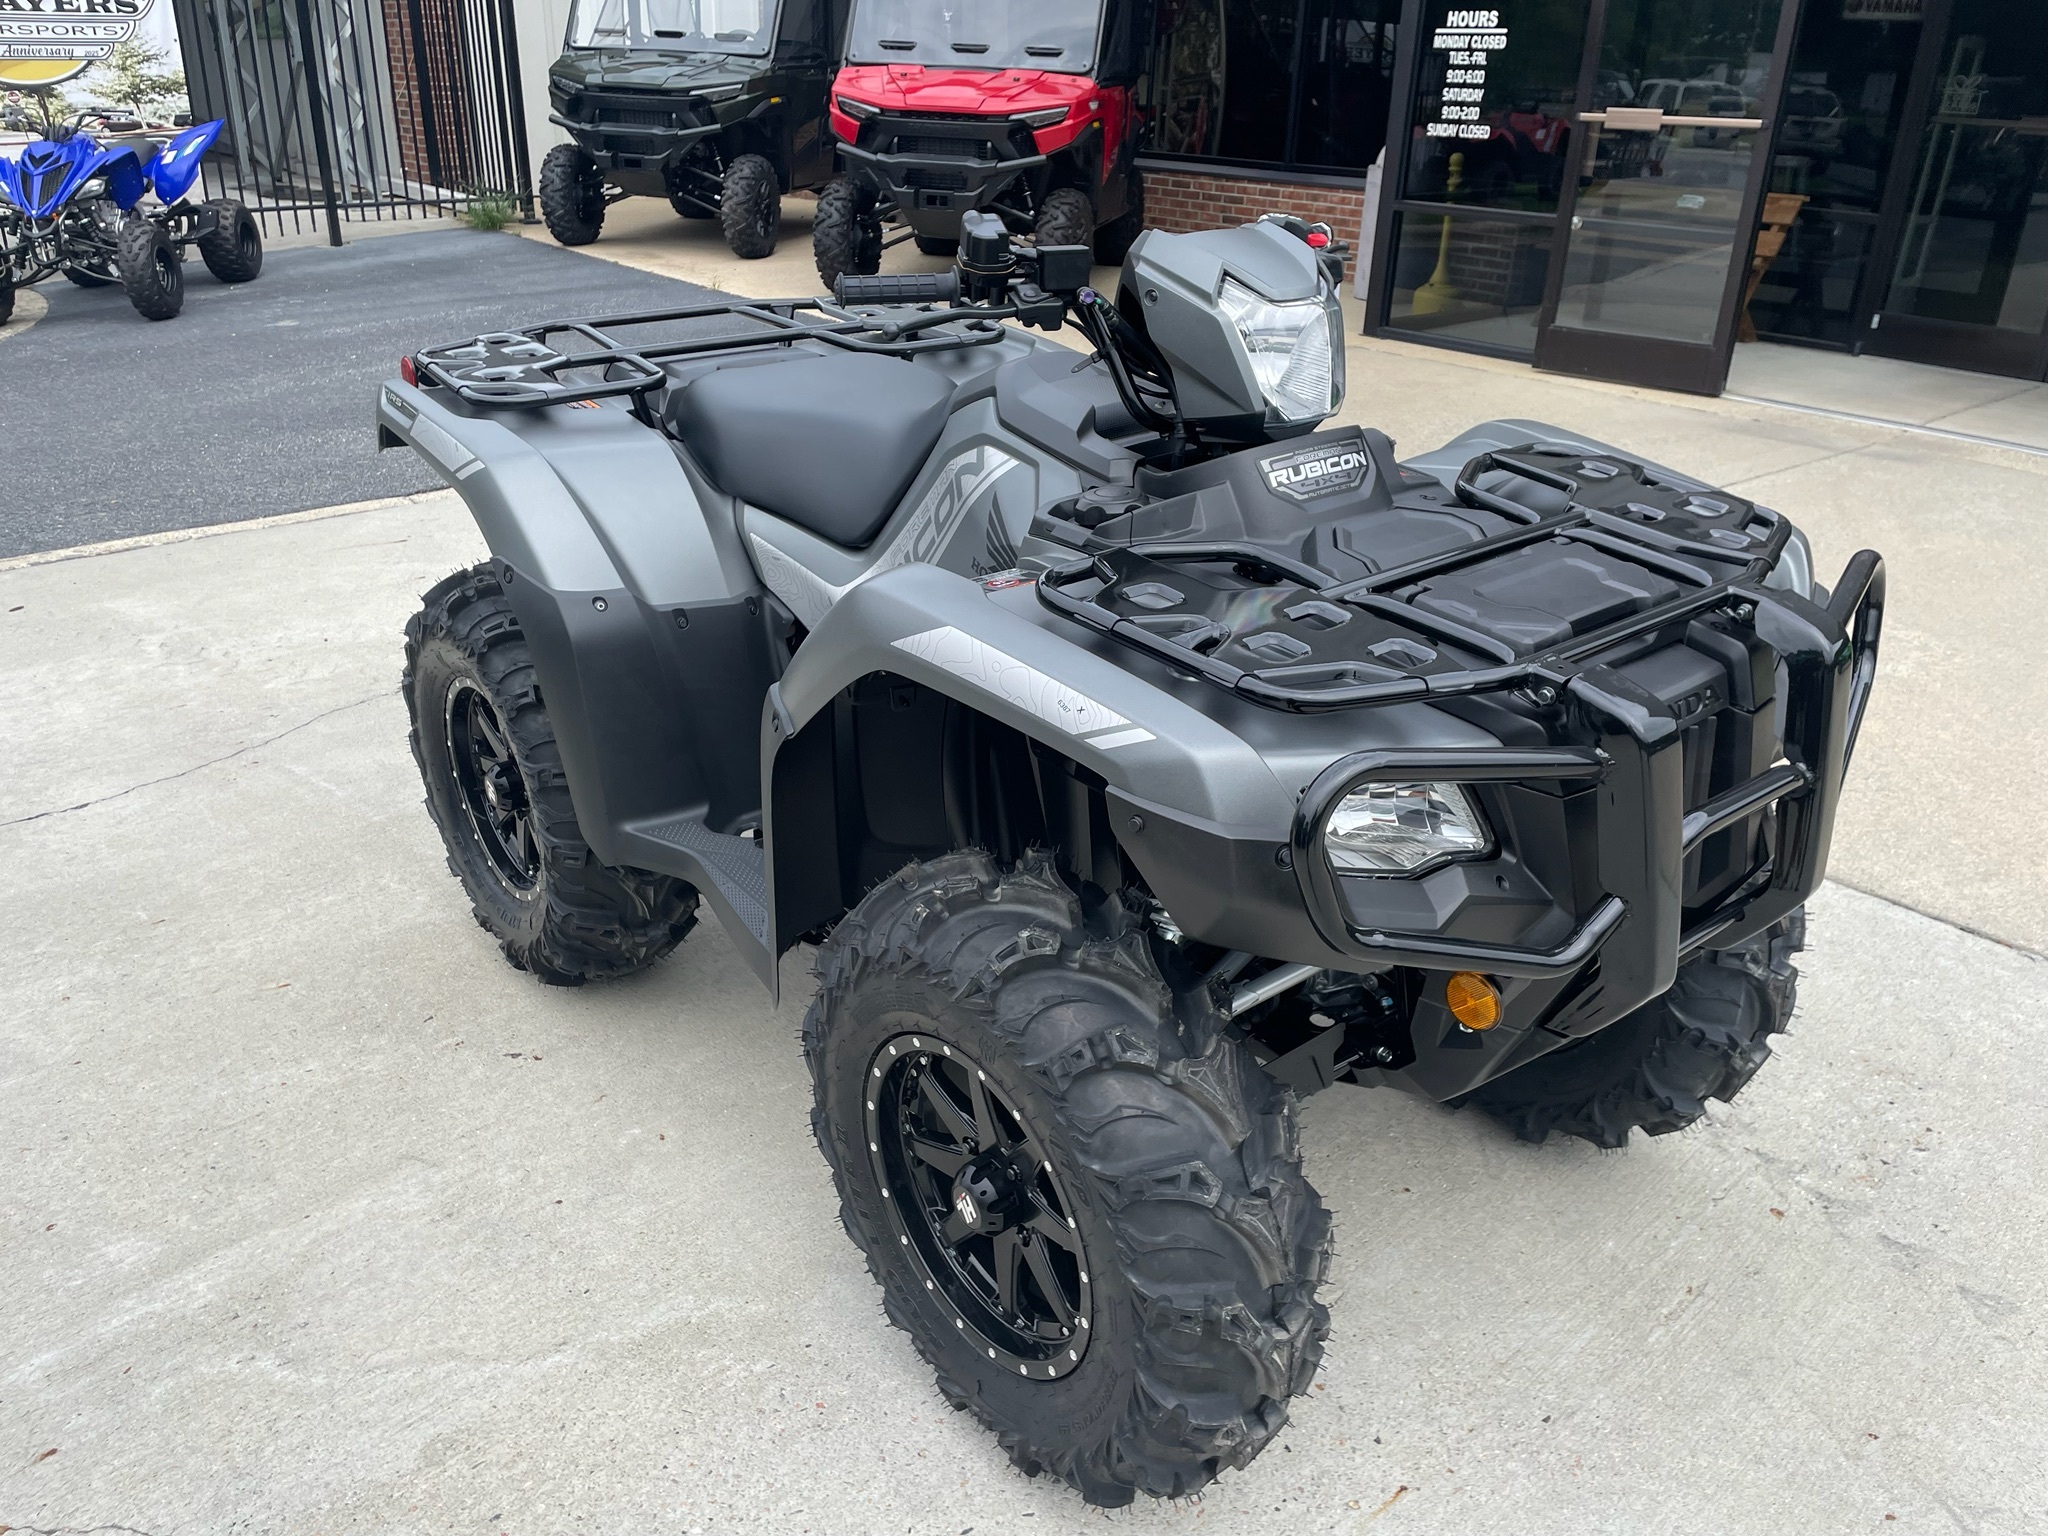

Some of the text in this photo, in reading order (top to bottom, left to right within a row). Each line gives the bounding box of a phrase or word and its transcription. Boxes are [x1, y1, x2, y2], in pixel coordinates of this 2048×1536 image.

[1446, 10, 1499, 28] HOURS
[1432, 35, 1508, 49] MONDAY CLOSED
[2, 44, 74, 60] Anniversary
[1441, 87, 1485, 102] SATURDAY
[1441, 106, 1481, 120] 9:00-2:00
[1426, 123, 1491, 139] SUNDAY CLOSED
[1295, 447, 1342, 463] FOREMAN
[1268, 451, 1367, 488] RUBICON
